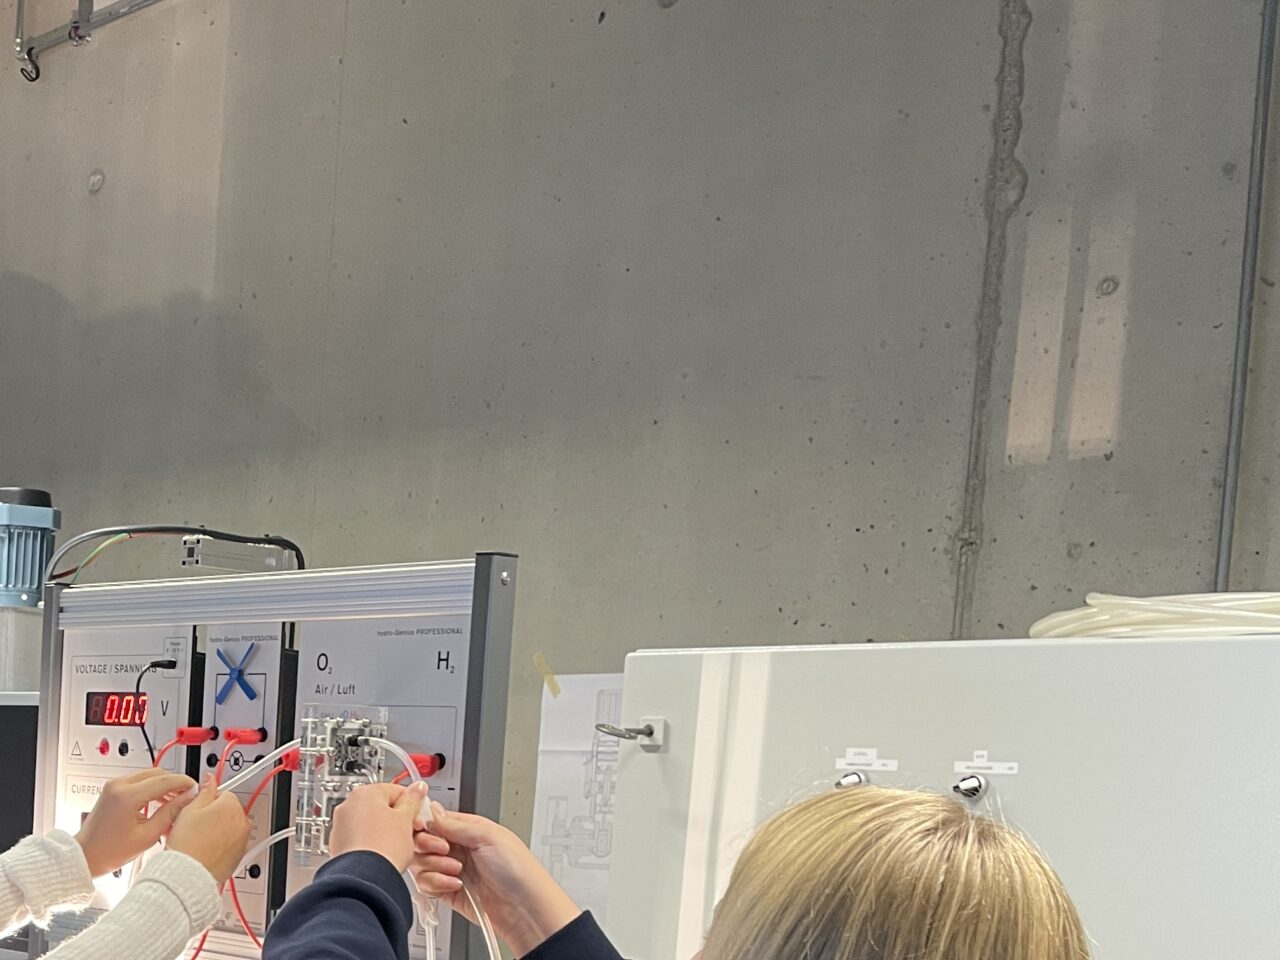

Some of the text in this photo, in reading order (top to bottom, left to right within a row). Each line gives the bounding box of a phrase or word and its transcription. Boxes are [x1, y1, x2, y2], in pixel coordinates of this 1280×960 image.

[74, 663, 108, 674] VOLTAGE
[314, 684, 329, 695] Air
[337, 683, 356, 695] Luft
[160, 699, 170, 717] V
[71, 784, 104, 796] CURREN
